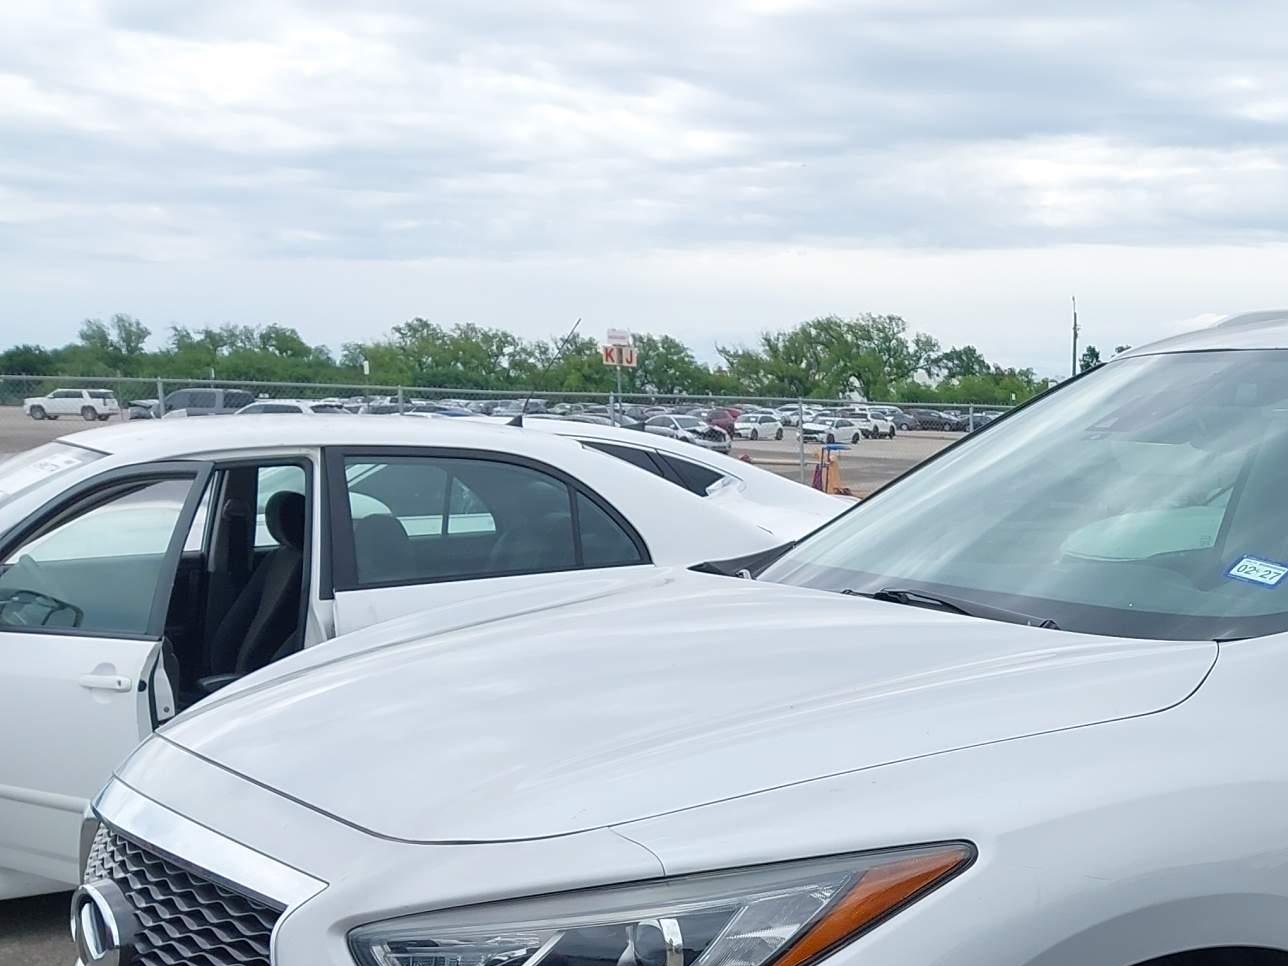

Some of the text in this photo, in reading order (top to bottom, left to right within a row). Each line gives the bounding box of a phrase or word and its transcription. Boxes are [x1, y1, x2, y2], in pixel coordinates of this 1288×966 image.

[605, 347, 615, 363] K
[1236, 564, 1257, 575] 02
[1258, 569, 1282, 581] 27
